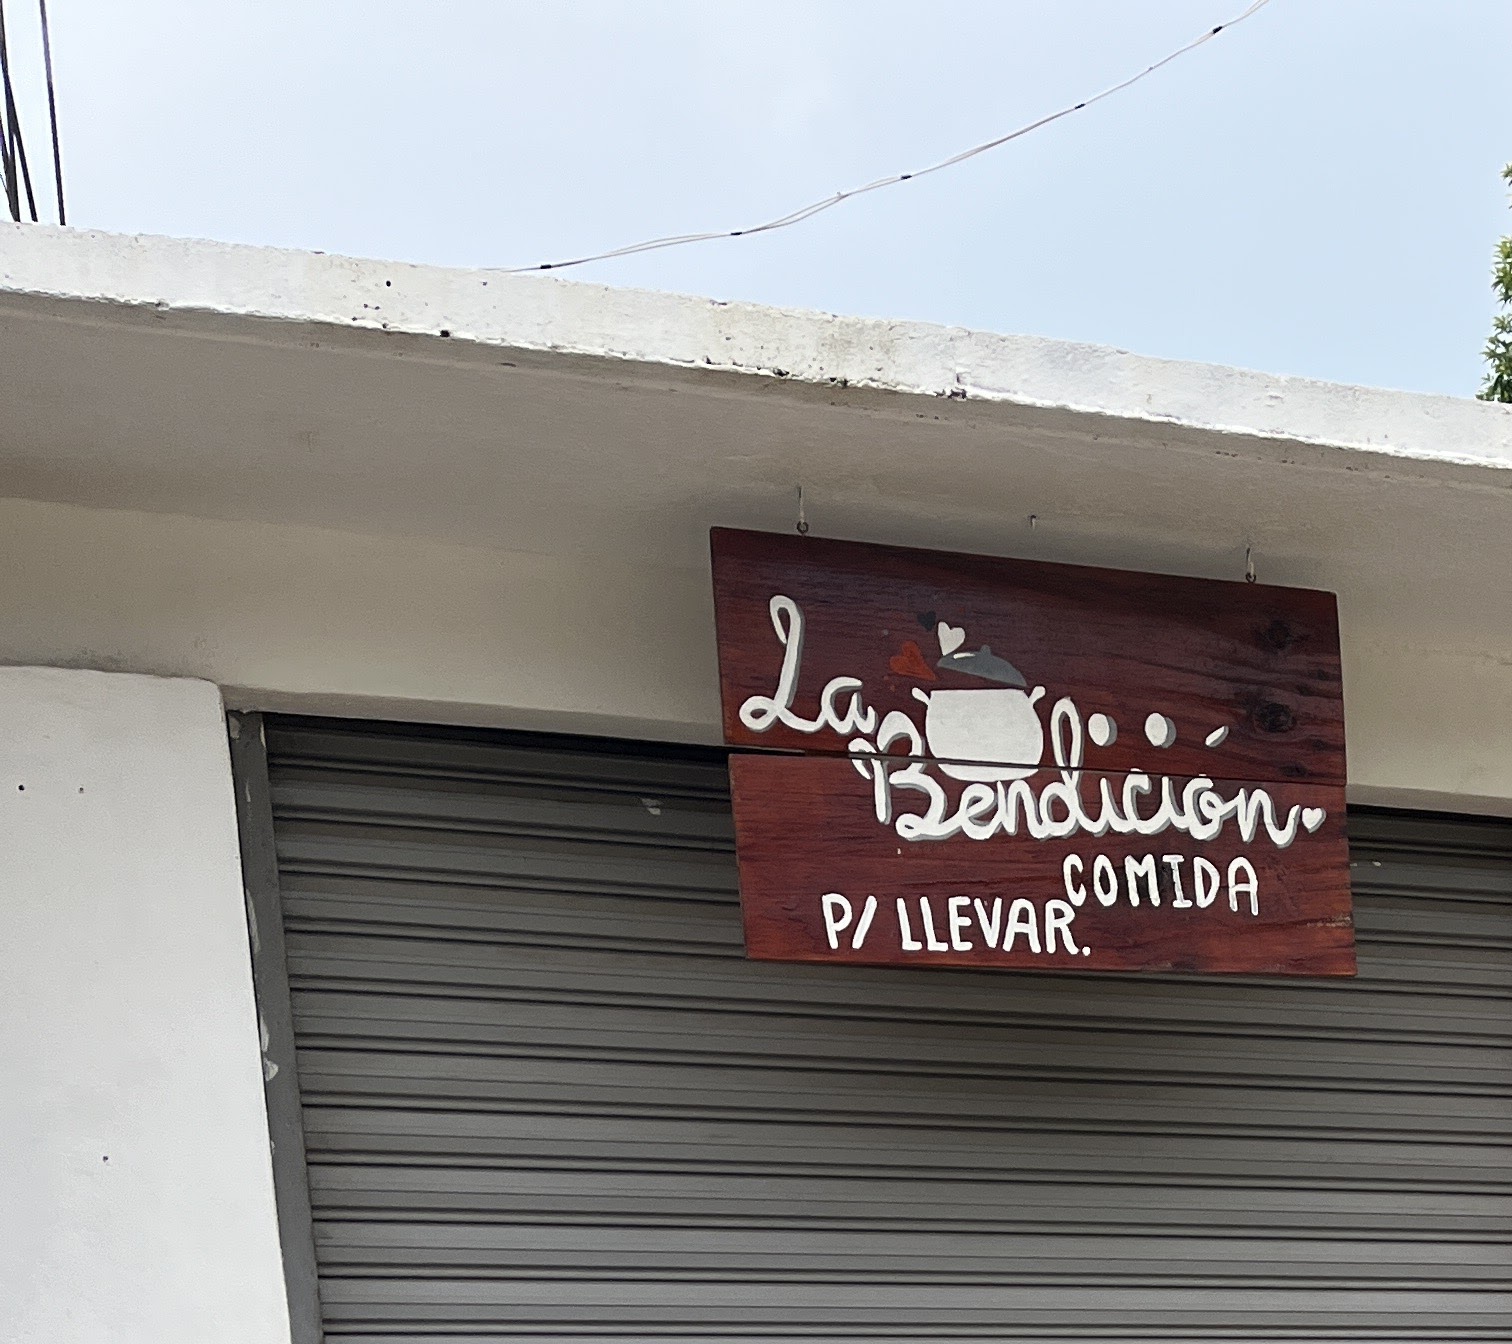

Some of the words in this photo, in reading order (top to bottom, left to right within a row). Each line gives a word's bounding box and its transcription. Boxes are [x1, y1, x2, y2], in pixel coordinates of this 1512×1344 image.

[738, 594, 877, 737] La
[1062, 852, 1260, 917] COMIDA
[821, 891, 879, 951] P/
[899, 895, 1093, 957] LLEVAR.
